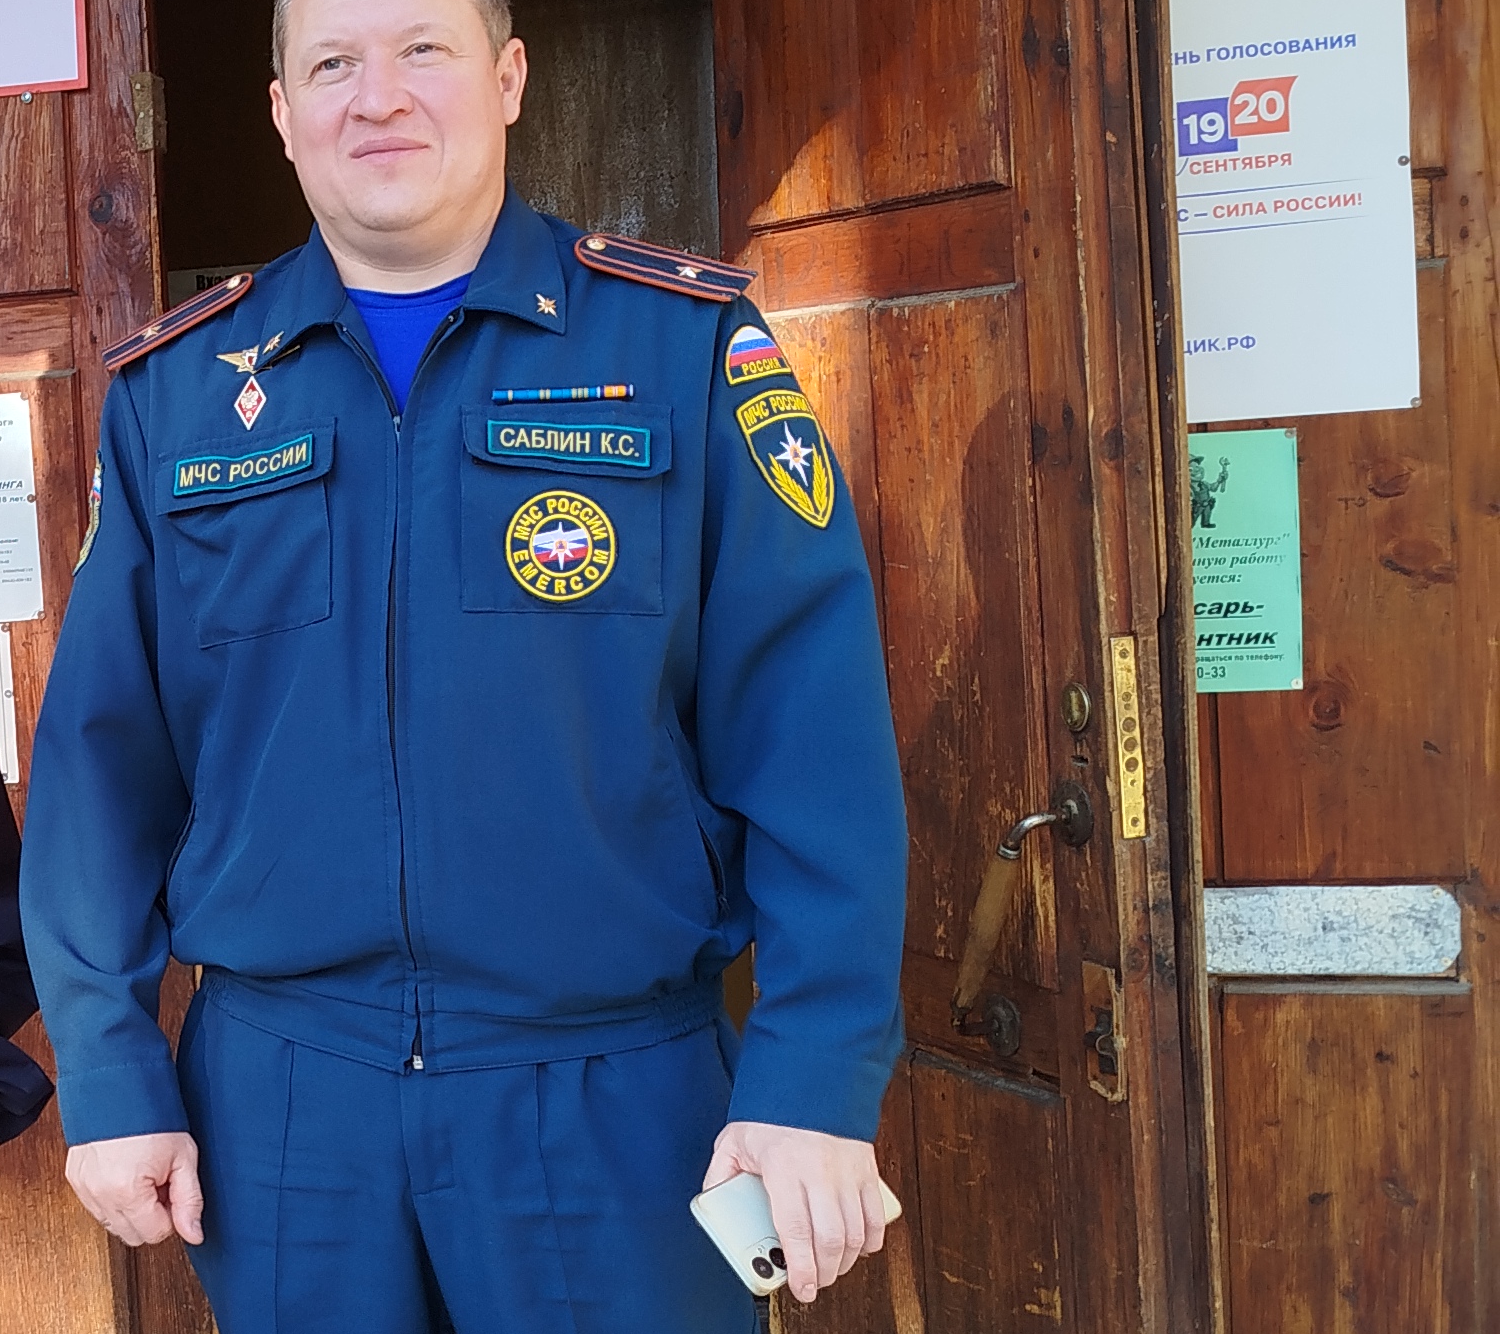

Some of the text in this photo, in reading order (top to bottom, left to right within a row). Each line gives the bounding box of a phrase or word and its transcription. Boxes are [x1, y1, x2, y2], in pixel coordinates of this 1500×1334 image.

[1170, 33, 1357, 66] НЬ ГОЛОСОВАНИЯ
[1182, 90, 1285, 145] 19 20
[1189, 153, 1292, 175] СЕНТЯБРЯ
[1212, 202, 1267, 219] СИЛА
[1273, 192, 1362, 213] РОССИИ!
[741, 356, 781, 376] РОССИЯ
[743, 395, 810, 427] МЧС РОССИИ
[500, 428, 640, 458] САБЛИН К.С.
[179, 442, 307, 488] МЧС РОССИИ
[513, 497, 608, 541] МЧС РОССИИ
[513, 549, 609, 595] EMERCOM
[1229, 552, 1287, 569] работу
[1193, 601, 1265, 618] сарь-
[1194, 632, 1278, 647] нтник
[1196, 666, 1227, 679] 0-33
